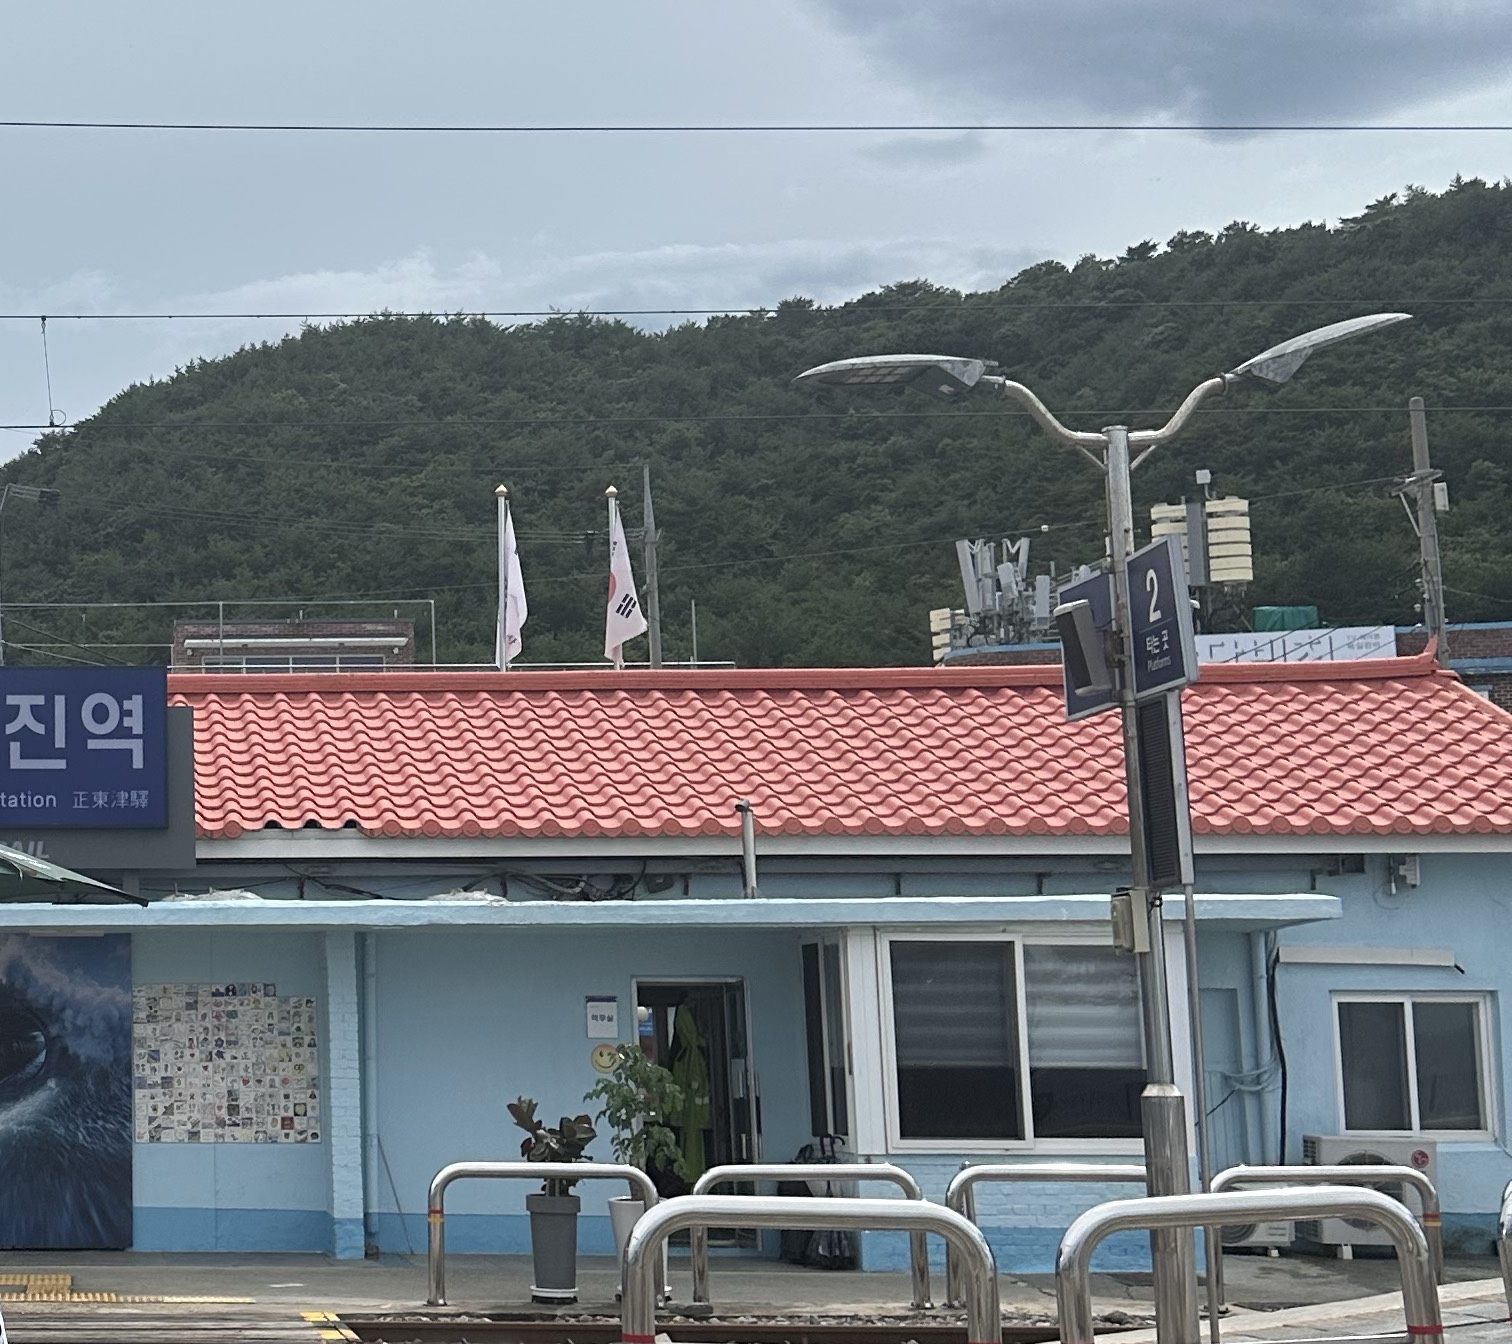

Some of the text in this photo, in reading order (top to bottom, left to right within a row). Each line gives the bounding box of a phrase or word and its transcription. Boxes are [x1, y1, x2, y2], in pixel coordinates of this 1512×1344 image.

[1146, 569, 1162, 623] 2
[72, 790, 149, 809] 正東津驛
